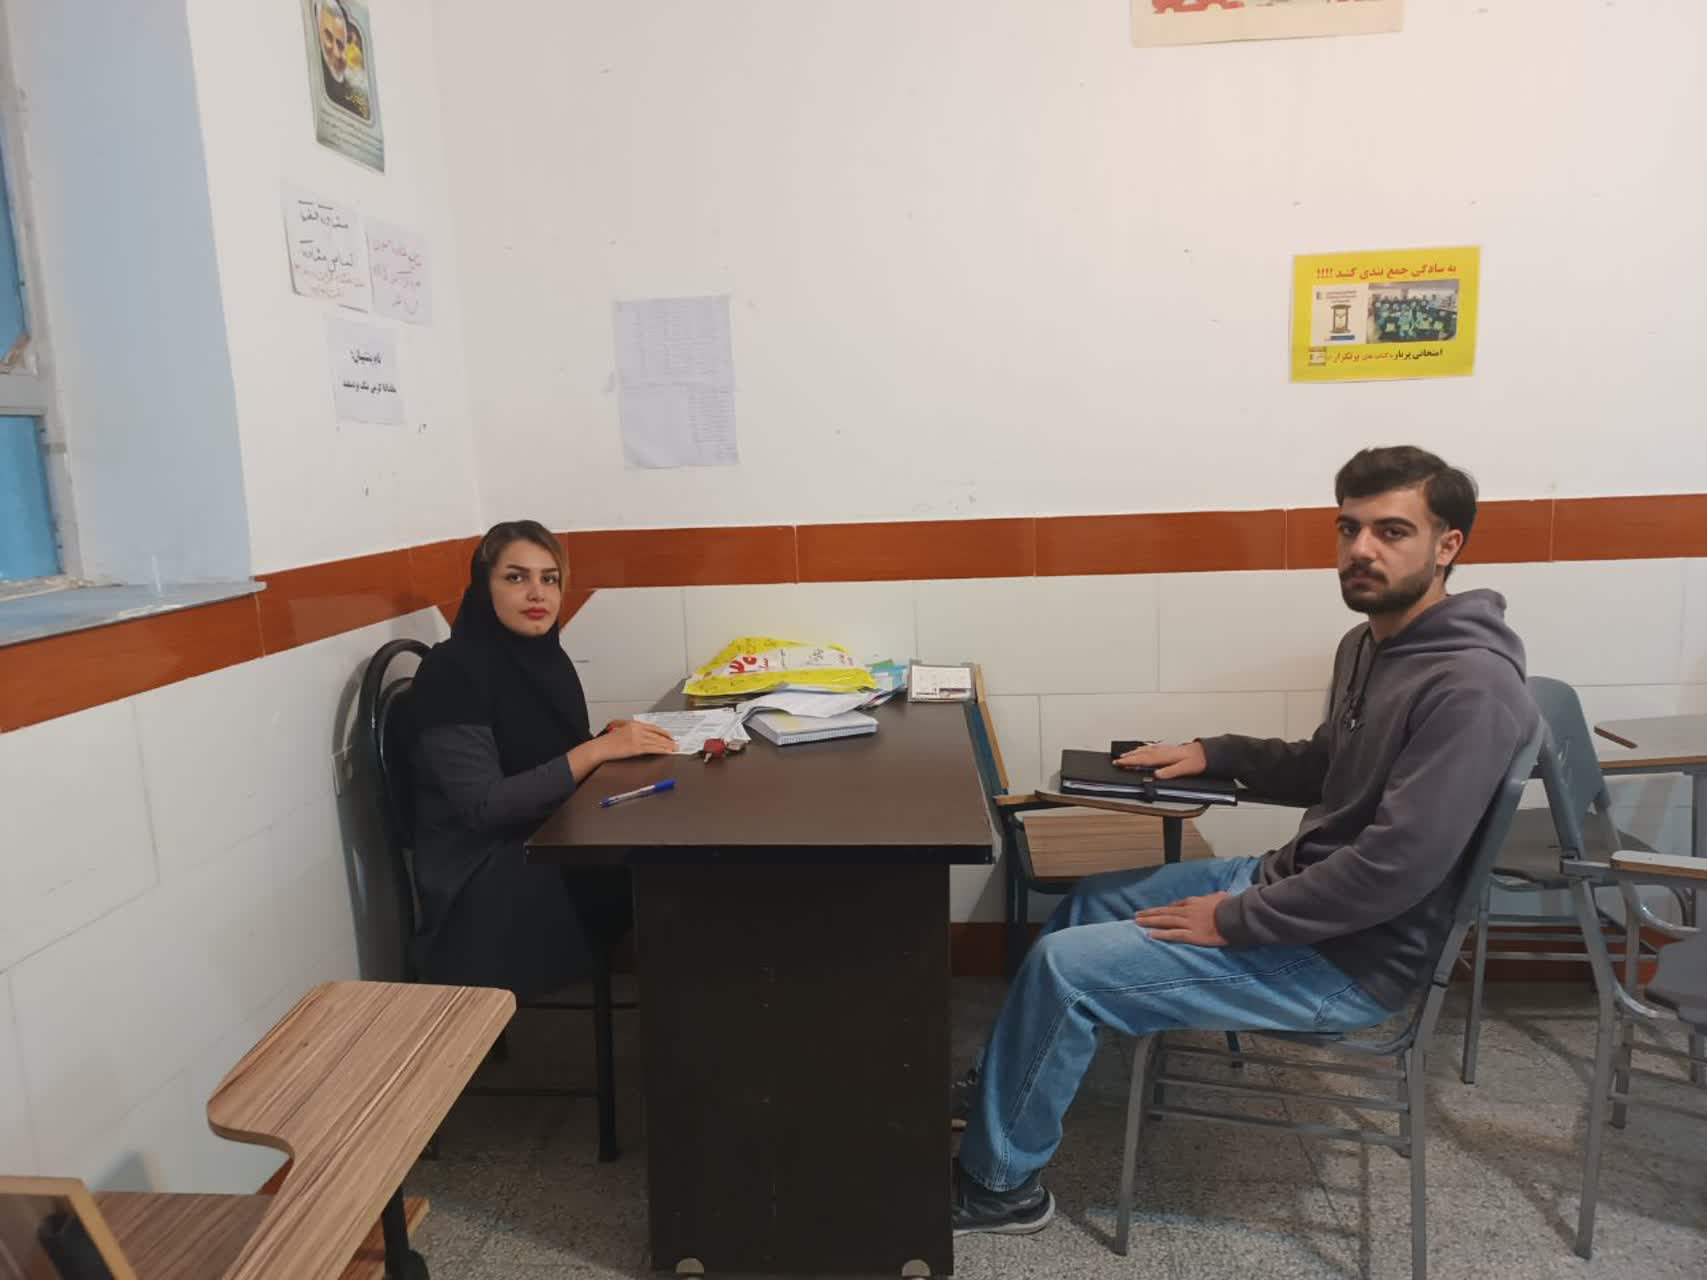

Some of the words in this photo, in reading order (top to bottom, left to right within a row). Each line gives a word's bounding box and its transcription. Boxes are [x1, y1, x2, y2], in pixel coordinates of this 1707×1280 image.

[1386, 266, 1409, 279] جمع
[1411, 263, 1445, 277] سادگی
[1447, 264, 1457, 273] به
[1412, 348, 1443, 360] امتحانی
